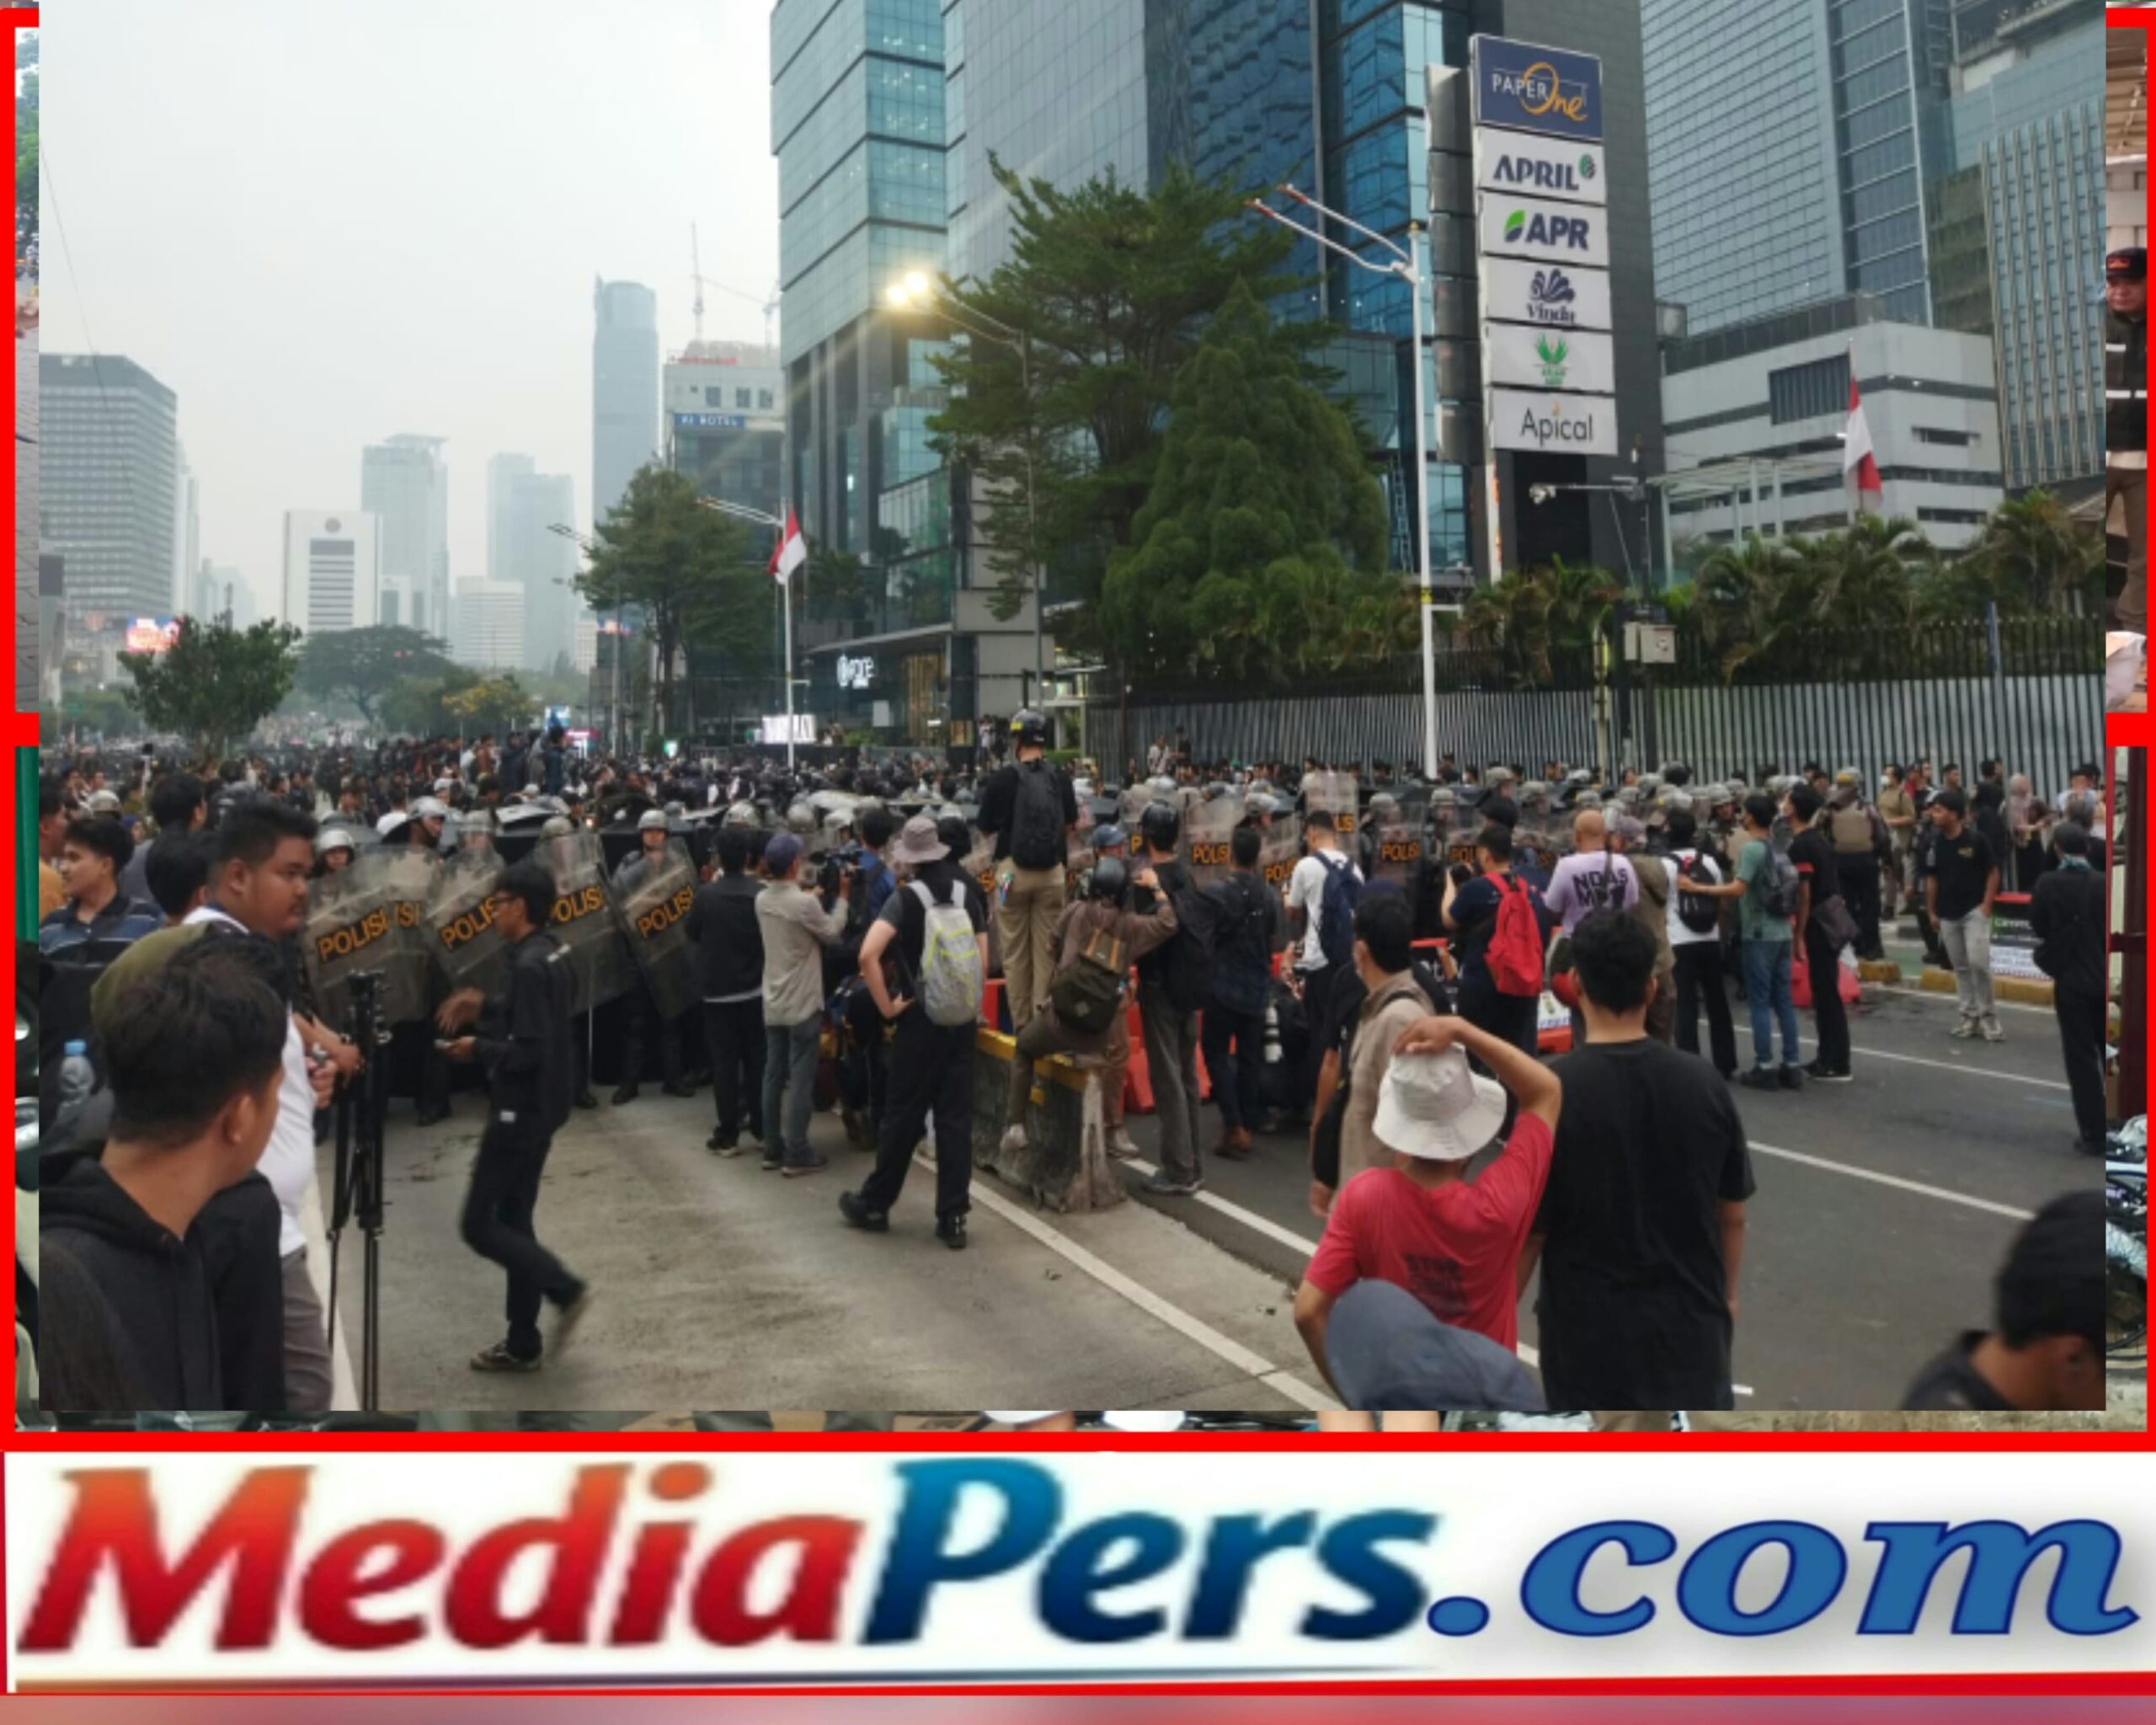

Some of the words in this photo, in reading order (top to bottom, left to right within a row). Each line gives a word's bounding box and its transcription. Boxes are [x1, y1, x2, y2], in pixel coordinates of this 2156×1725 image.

[1492, 73, 1548, 100] PAPER
[1520, 61, 1588, 121] One
[1493, 155, 1579, 190] APRIL
[1525, 212, 1589, 250] APR
[1520, 403, 1593, 447] Apical
[318, 909, 390, 960] POLISI
